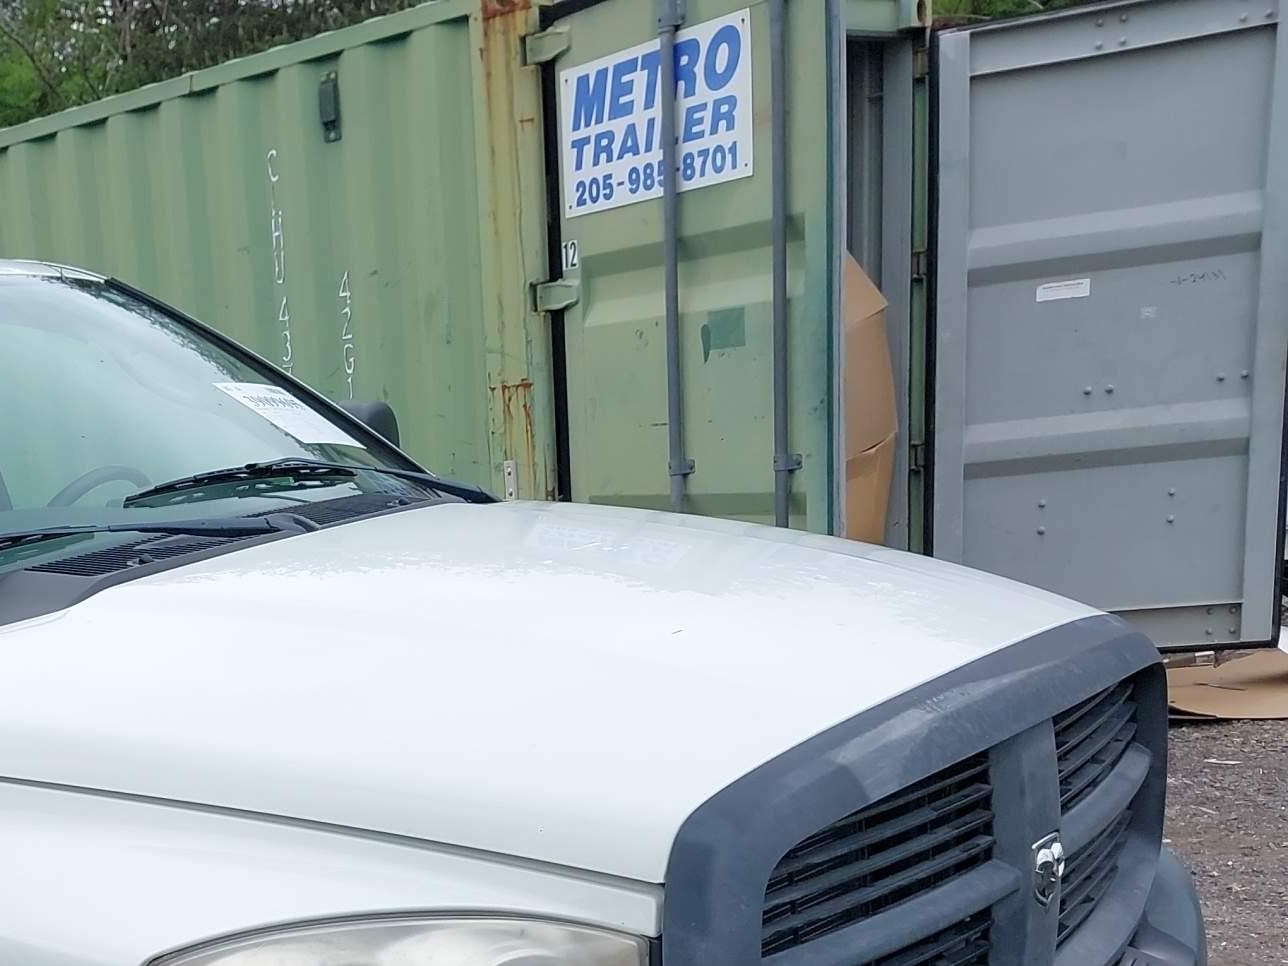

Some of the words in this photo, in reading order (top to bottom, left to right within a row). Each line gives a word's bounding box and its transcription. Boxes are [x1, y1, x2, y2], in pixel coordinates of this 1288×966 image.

[572, 25, 742, 132] METRO
[571, 95, 739, 171] TRAIER
[563, 241, 577, 269] 12
